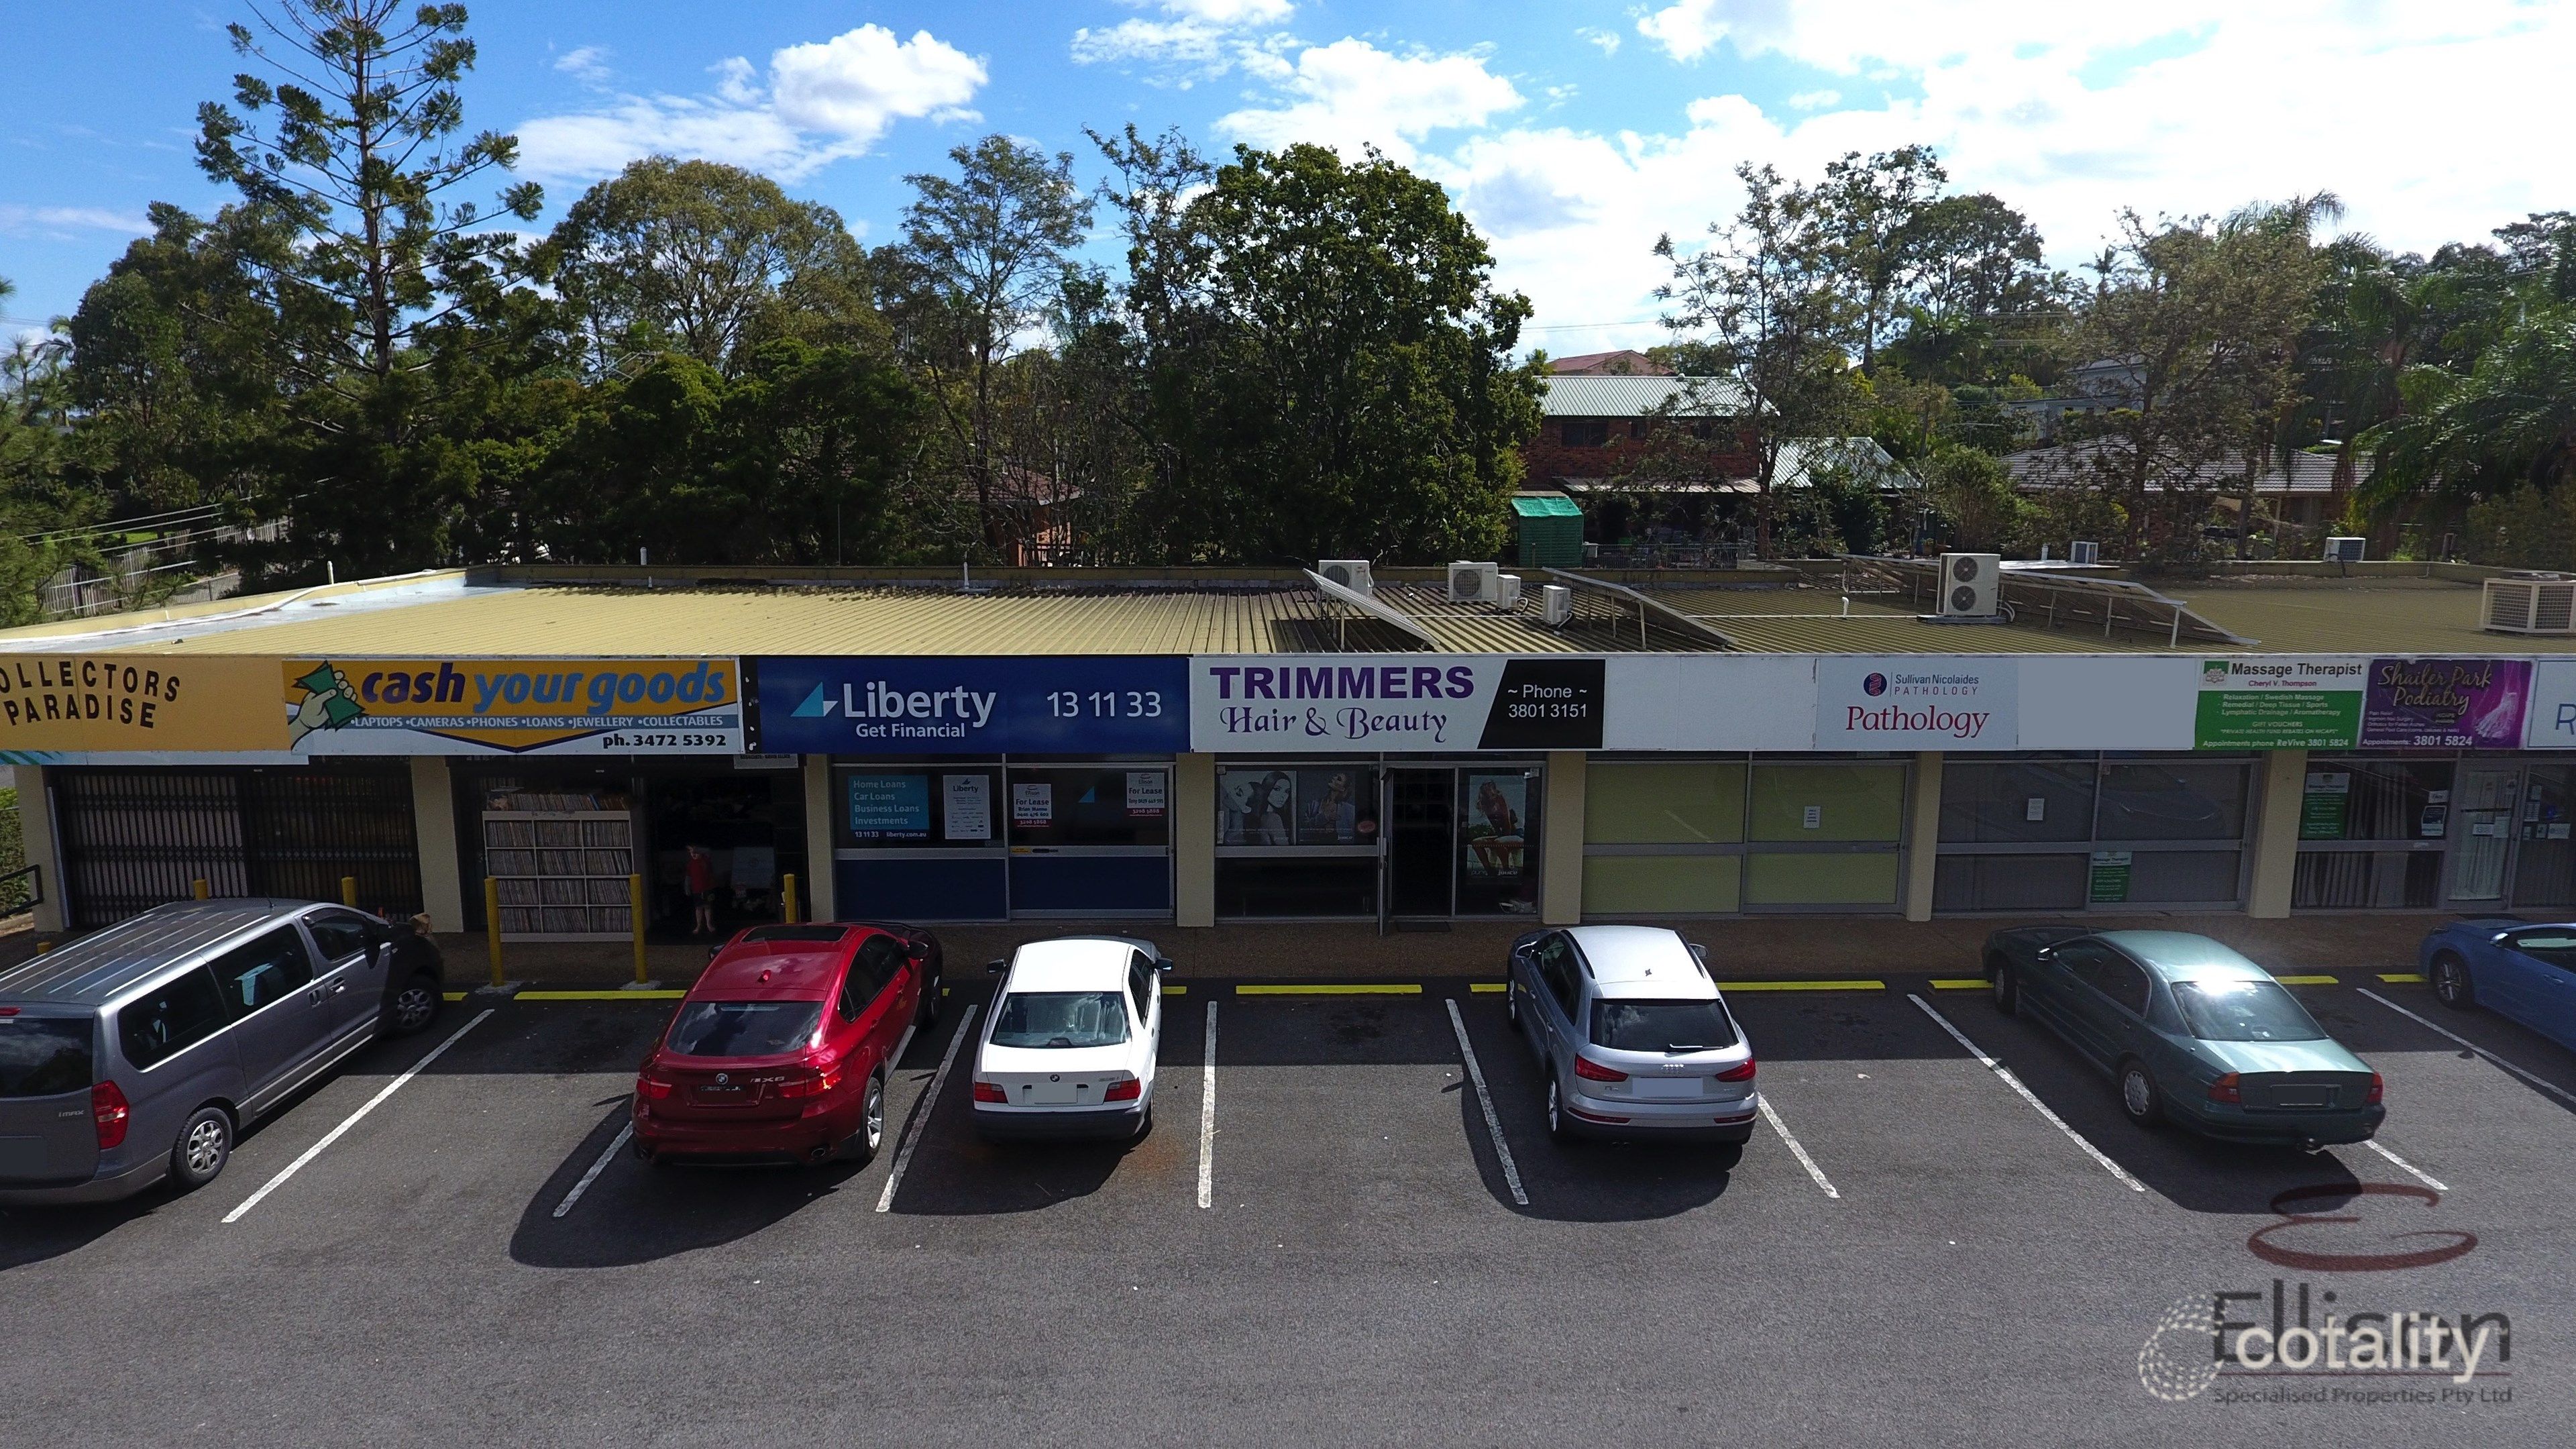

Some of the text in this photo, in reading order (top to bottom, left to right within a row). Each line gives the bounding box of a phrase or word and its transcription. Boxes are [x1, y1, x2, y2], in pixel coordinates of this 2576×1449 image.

[2231, 663, 2362, 678] Massage Therapist
[2377, 661, 2492, 688] Shailer Park
[1210, 666, 1474, 699] TRIMMERS
[1895, 674, 1979, 684] Sullivan Nicolaides
[2282, 680, 2317, 688] Thompson
[361, 661, 725, 716] cash your goods
[1523, 685, 1572, 698] Phone
[1894, 686, 1978, 696] PATHOLOGY
[843, 681, 997, 727] Liberty
[1046, 691, 1162, 717] 13 11 33
[2392, 684, 2470, 716] Podiatry
[3, 694, 156, 729] PARADISE
[1508, 703, 1587, 718] 3801 3151
[1220, 706, 1448, 743] Hair & Beauty
[1845, 705, 1990, 738] Pathology
[855, 722, 965, 738] Get Financial
[603, 733, 727, 749] ph. 3472 5392
[2413, 735, 2441, 746] 3801
[2444, 735, 2473, 746] 5824
[853, 780, 906, 788] Home Loans
[953, 785, 979, 793] Liberty
[854, 792, 896, 800] Car Loans
[855, 804, 920, 812] Business Loans
